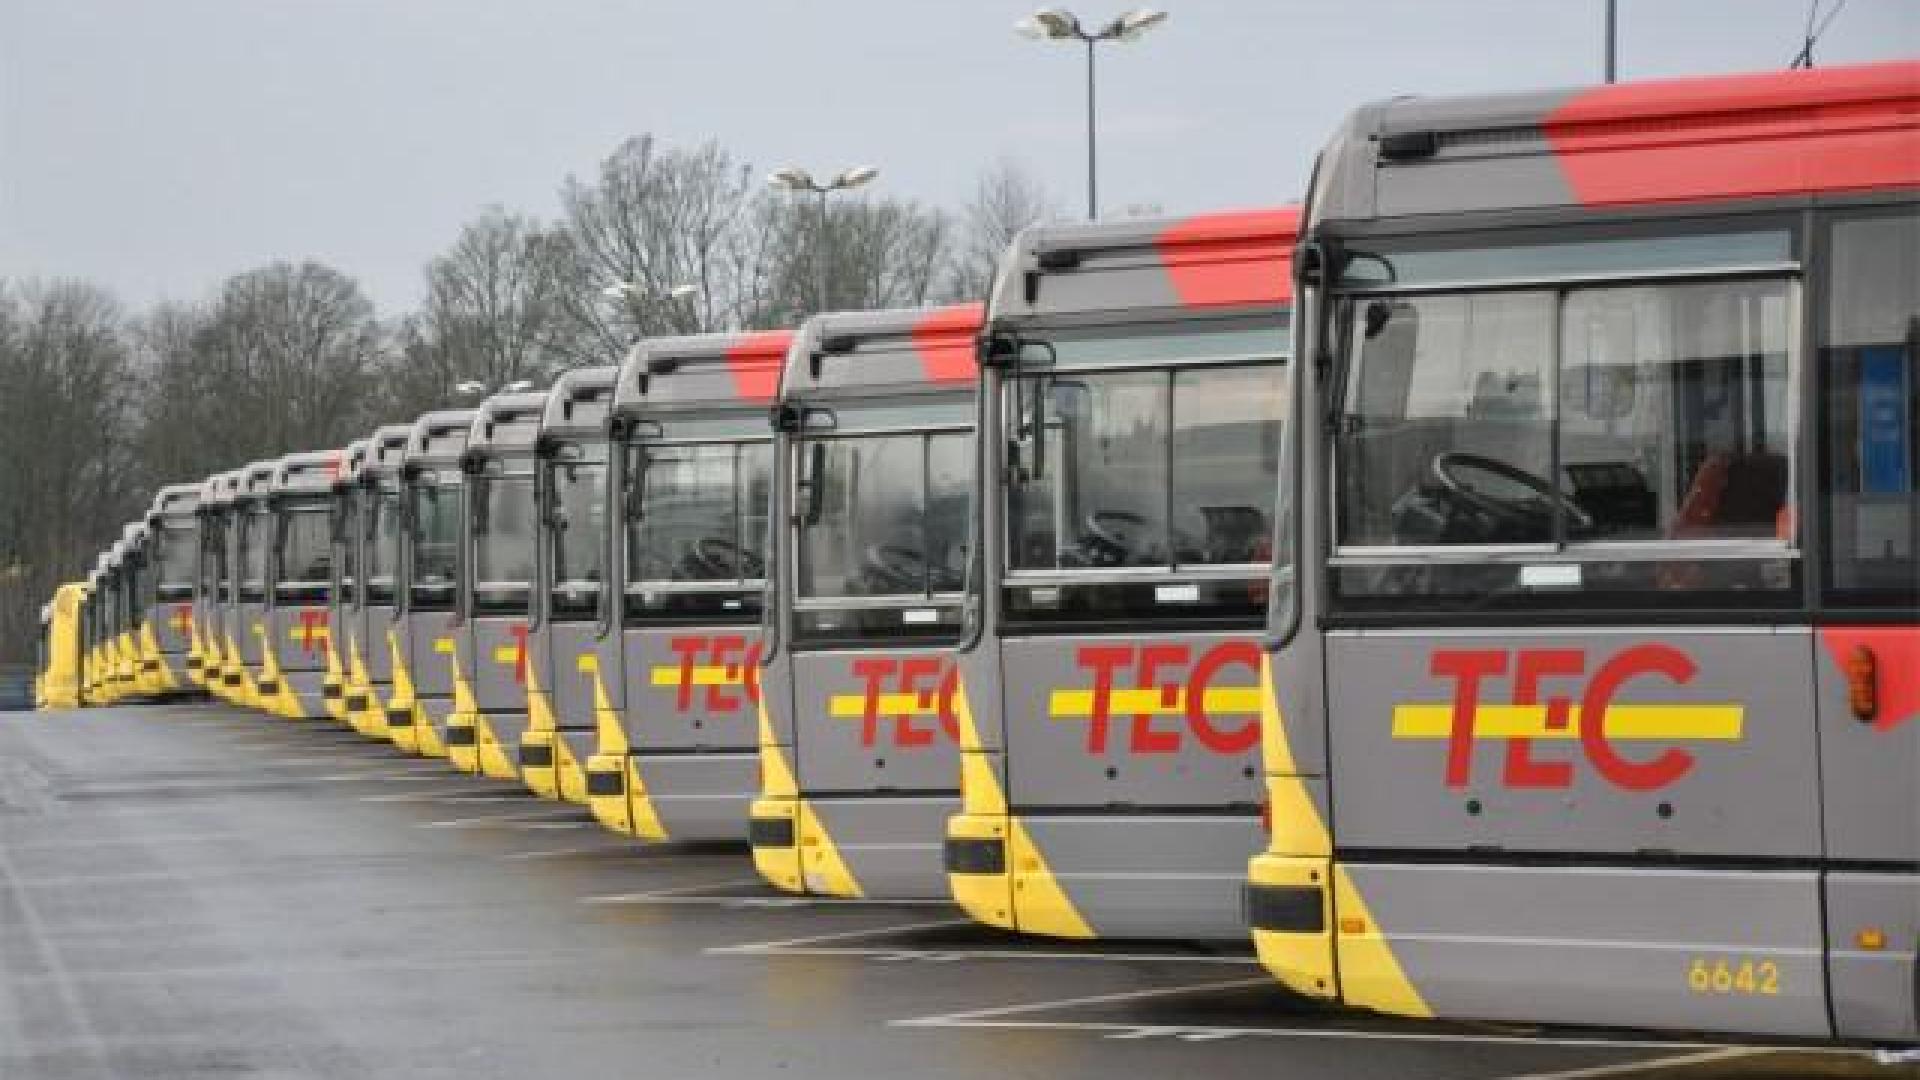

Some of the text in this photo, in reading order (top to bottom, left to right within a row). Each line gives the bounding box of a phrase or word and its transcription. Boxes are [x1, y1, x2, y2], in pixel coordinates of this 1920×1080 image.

[1076, 641, 1261, 755] TEC
[1431, 642, 1697, 790] TEC
[1688, 959, 1780, 995] 6642
